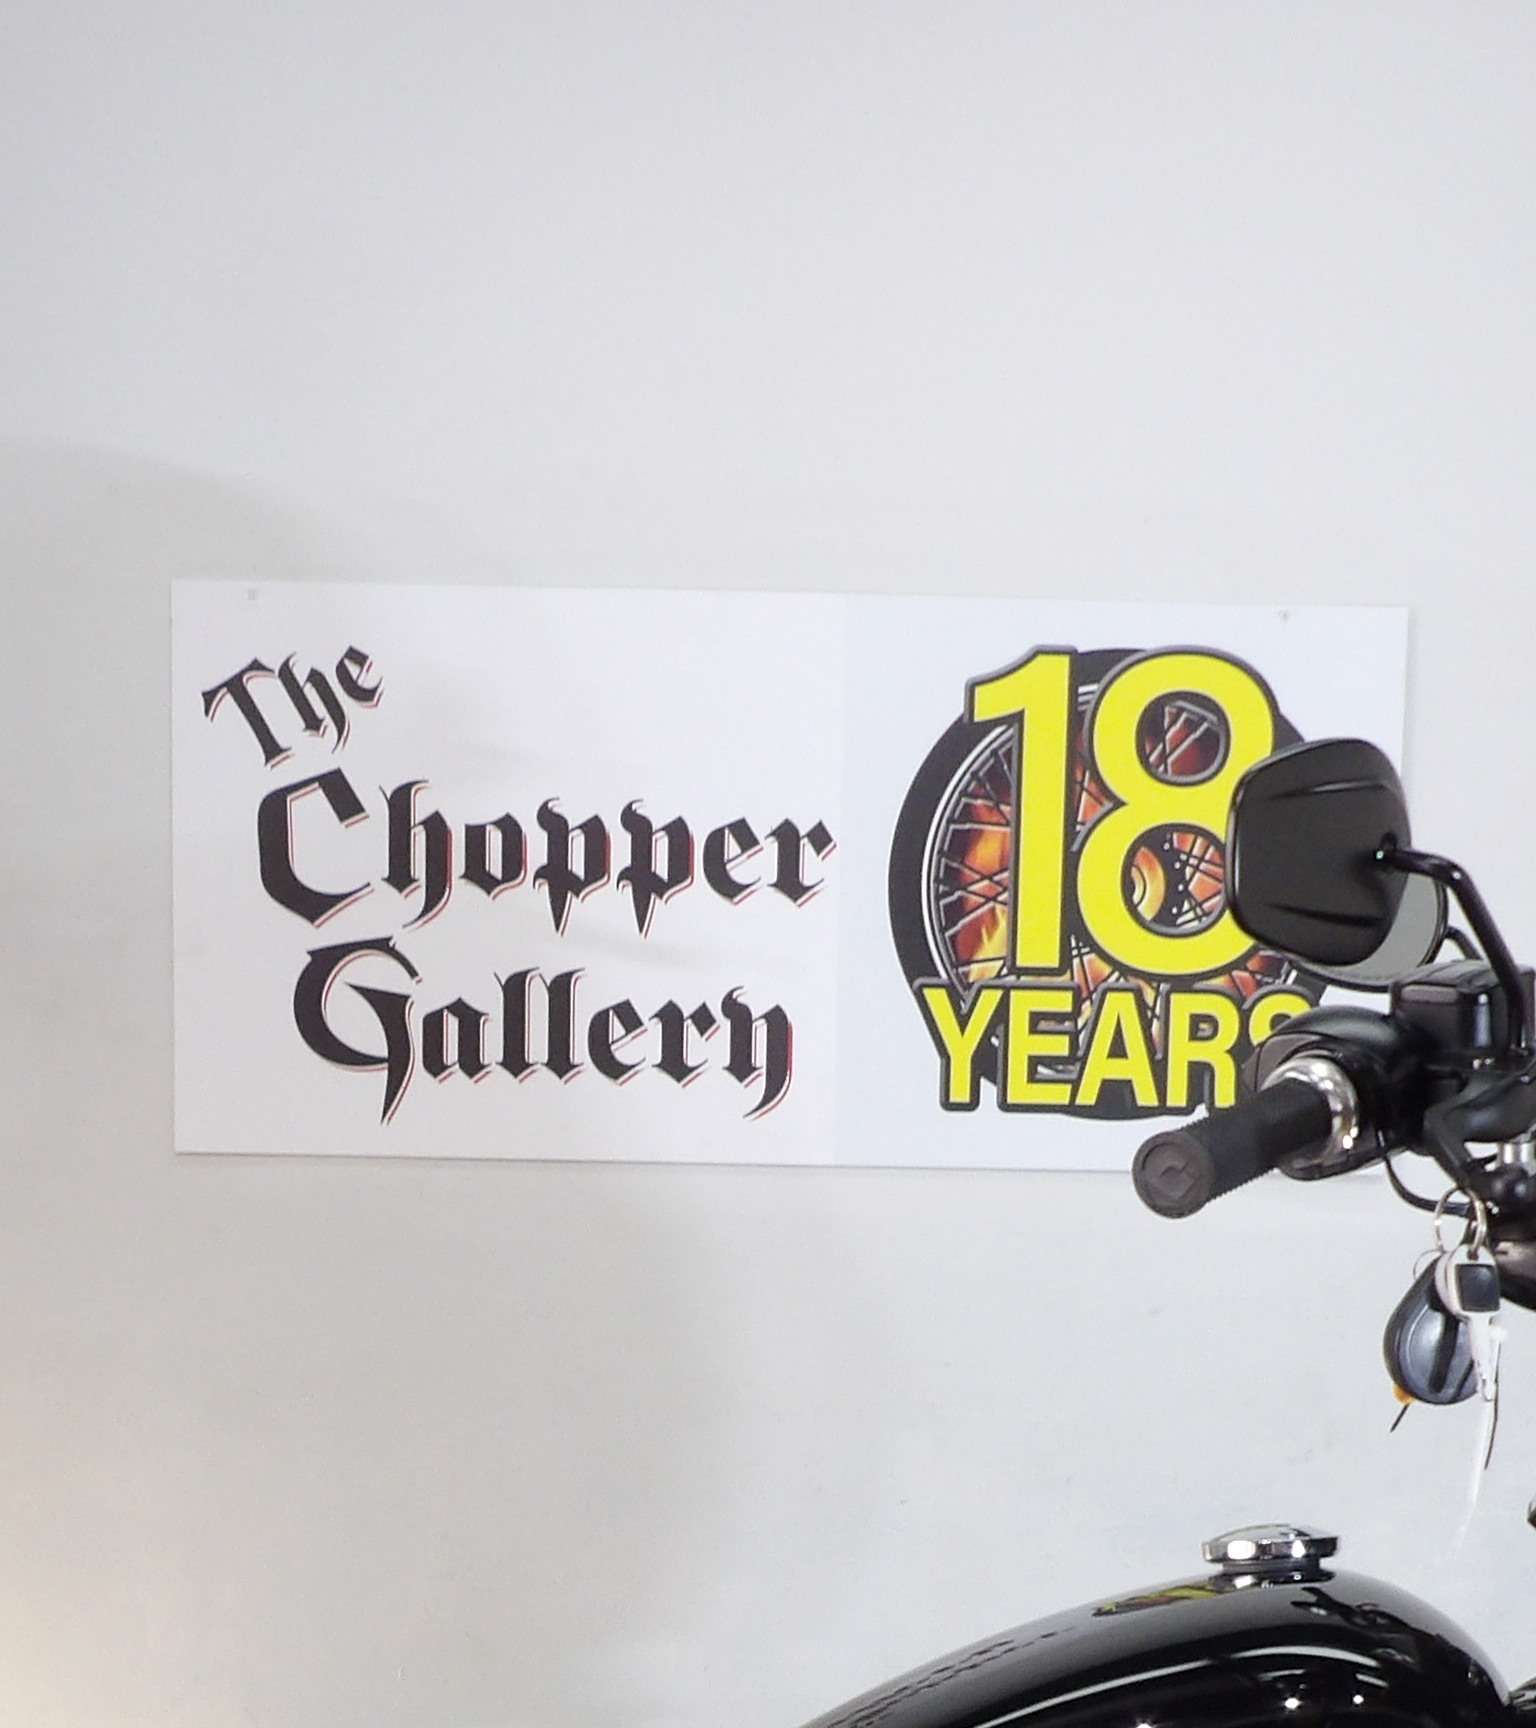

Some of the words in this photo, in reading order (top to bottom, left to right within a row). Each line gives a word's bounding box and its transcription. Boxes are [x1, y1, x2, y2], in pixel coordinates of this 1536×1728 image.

[201, 645, 383, 770] The
[257, 767, 837, 938] Chopper
[972, 652, 1275, 976] 18
[292, 935, 793, 1126] Gallery
